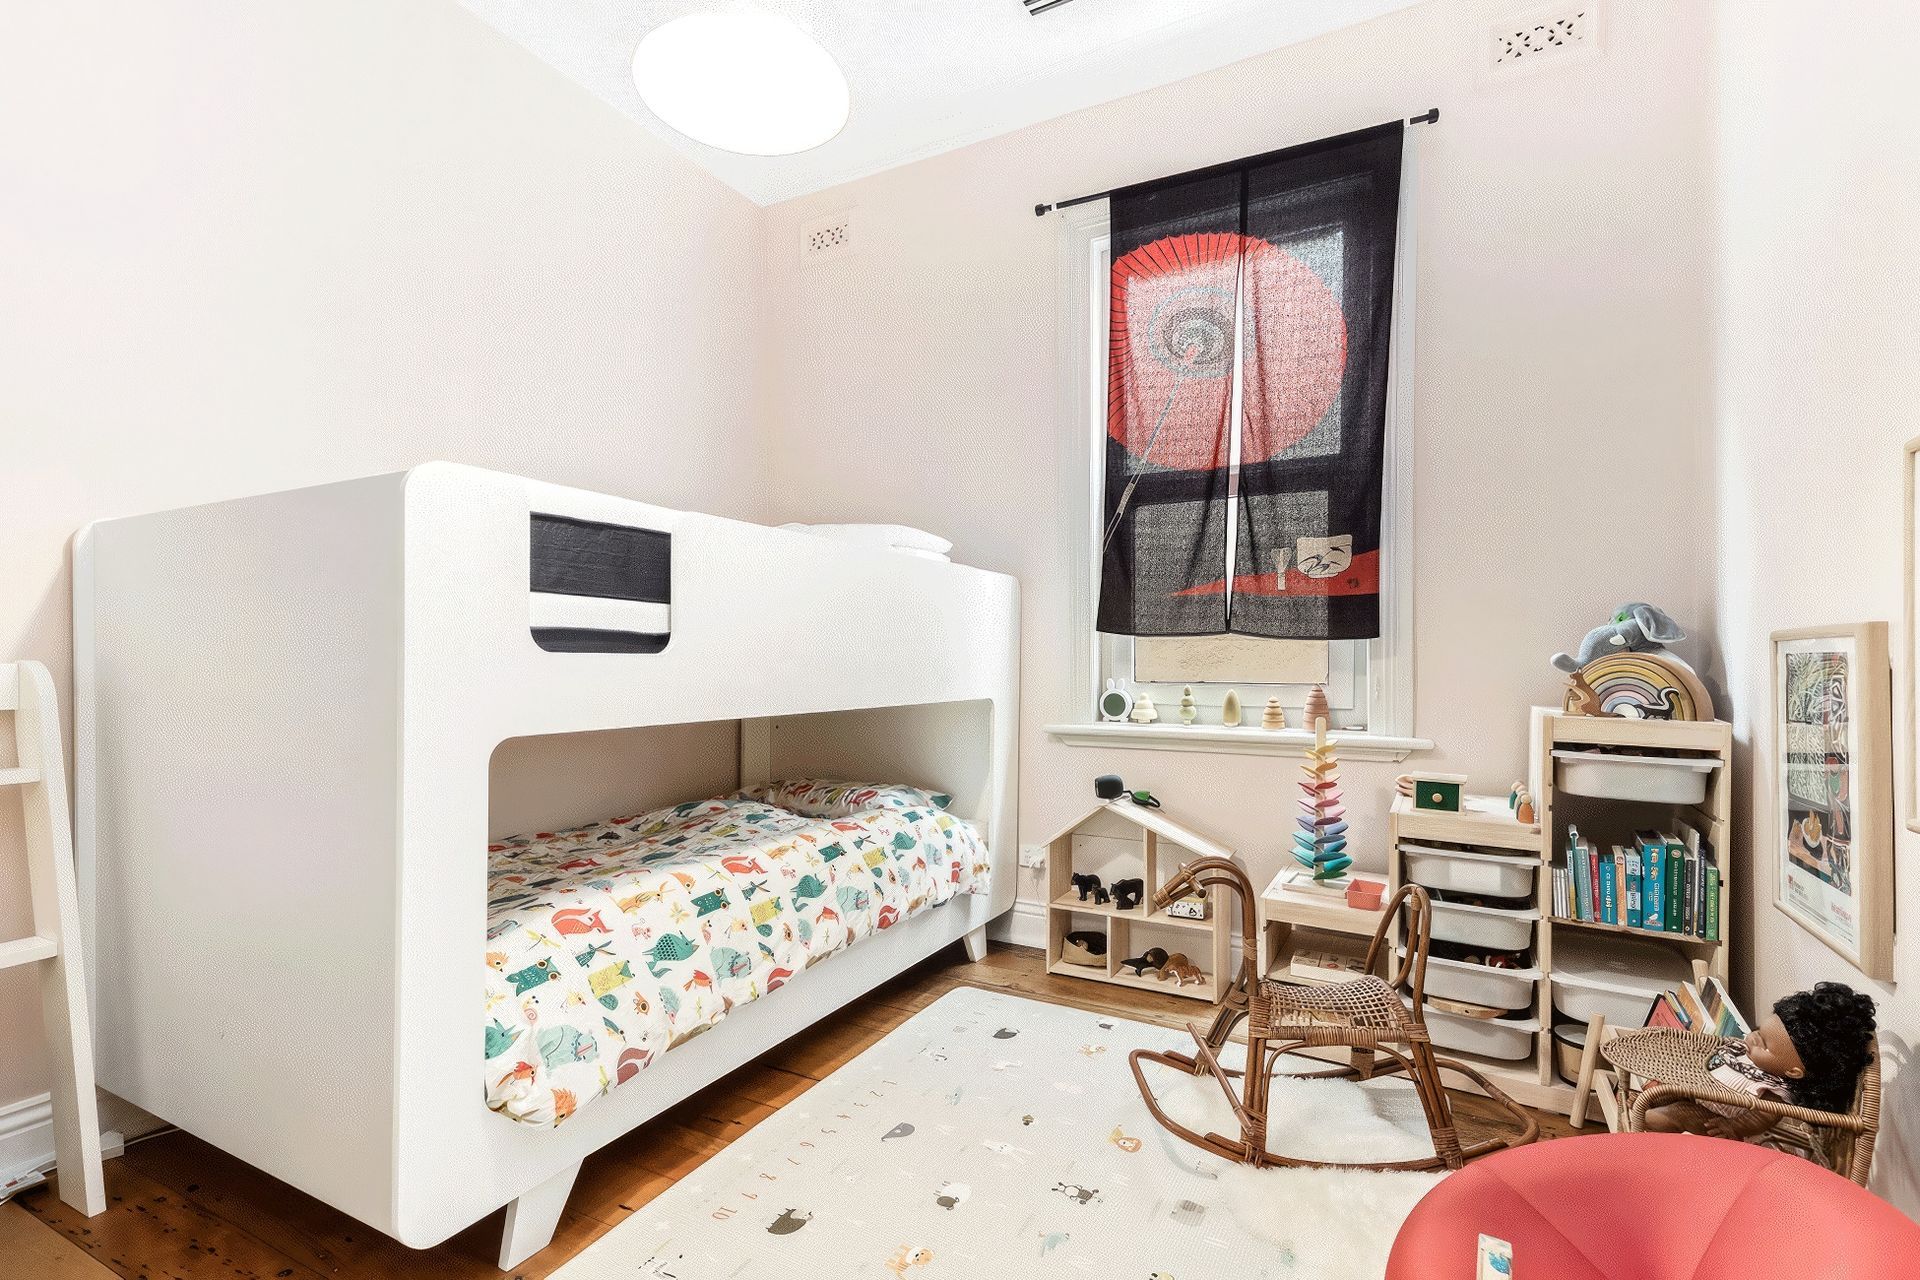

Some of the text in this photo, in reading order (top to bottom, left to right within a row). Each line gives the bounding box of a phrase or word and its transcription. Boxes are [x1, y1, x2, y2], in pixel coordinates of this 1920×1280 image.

[759, 1172, 777, 1181] 8
[741, 1192, 758, 1200] 9
[712, 1206, 738, 1220] 10
